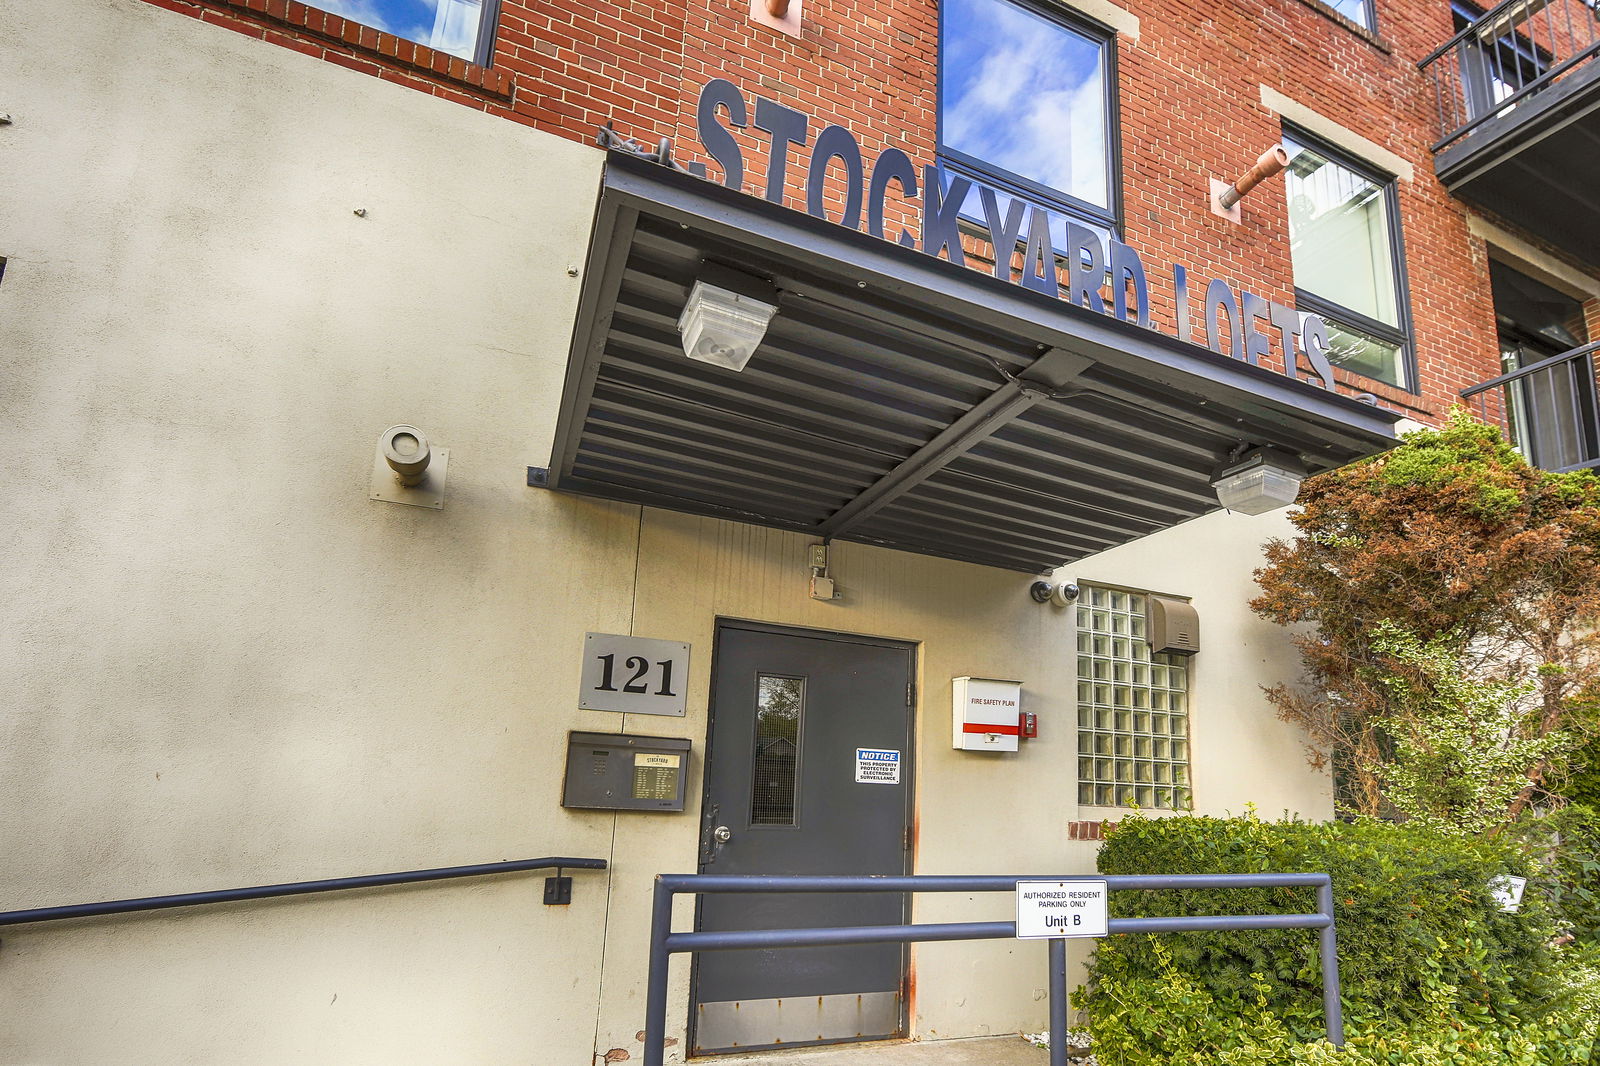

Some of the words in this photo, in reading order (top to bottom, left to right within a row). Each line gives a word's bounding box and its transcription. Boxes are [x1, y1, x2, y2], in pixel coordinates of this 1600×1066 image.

[688, 78, 1150, 329] STOCKYARD
[1173, 263, 1335, 393] LOFTS
[594, 653, 676, 696] 121
[861, 752, 896, 760] NOTICE
[1023, 891, 1066, 899] AUTHORIZED
[1068, 891, 1101, 899] RESIDENT
[1038, 900, 1067, 908] PARKING
[1069, 900, 1087, 908] ONLY
[1045, 915, 1068, 927] Unit
[1073, 914, 1081, 926] B
